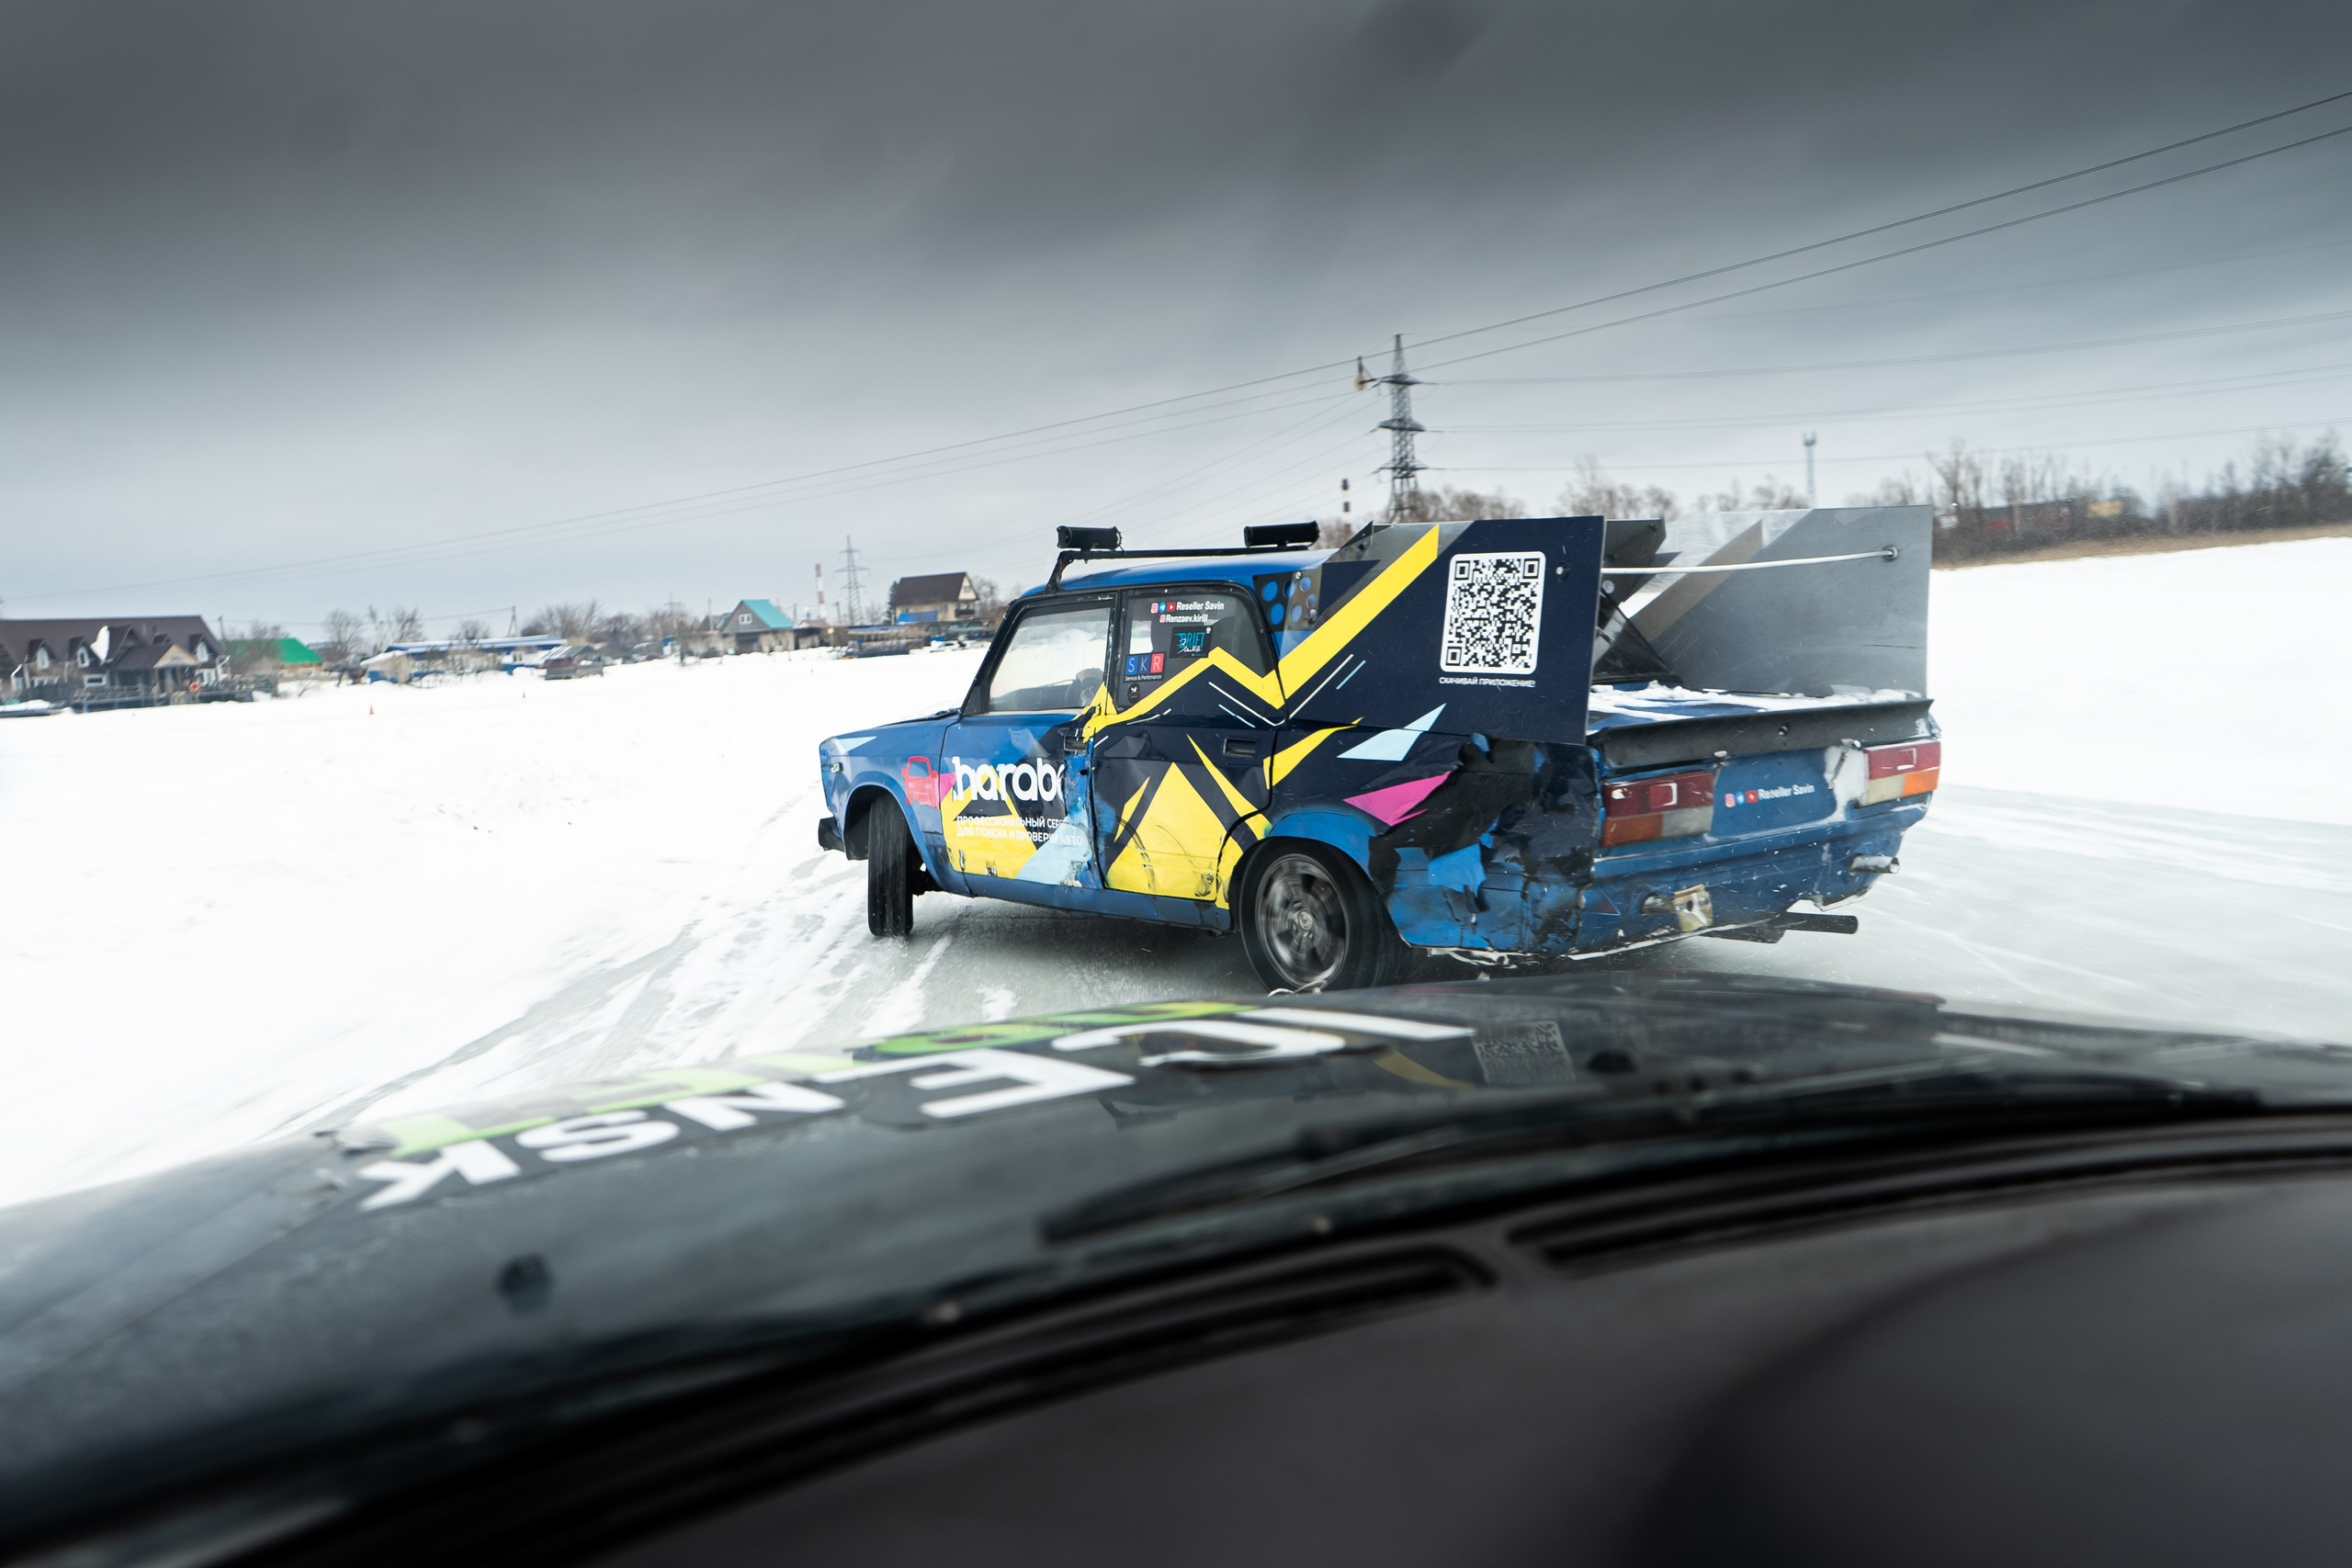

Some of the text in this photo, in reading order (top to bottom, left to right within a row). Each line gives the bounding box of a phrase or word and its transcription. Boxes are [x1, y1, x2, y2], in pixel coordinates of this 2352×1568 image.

[1176, 600, 1225, 611] Reseller Savin
[1175, 632, 1205, 649] DRIFT
[1127, 656, 1161, 673] SKR
[1439, 676, 1478, 685] СКАЧИВАЙ
[1758, 783, 1815, 800] Reseller Savin
[956, 816, 1046, 829] ПРОФЕССИОНАЛЬНЫЙ
[956, 827, 974, 838] ДЛЯ
[975, 828, 1008, 839] ПОИСКА
[1009, 829, 1016, 840] И
